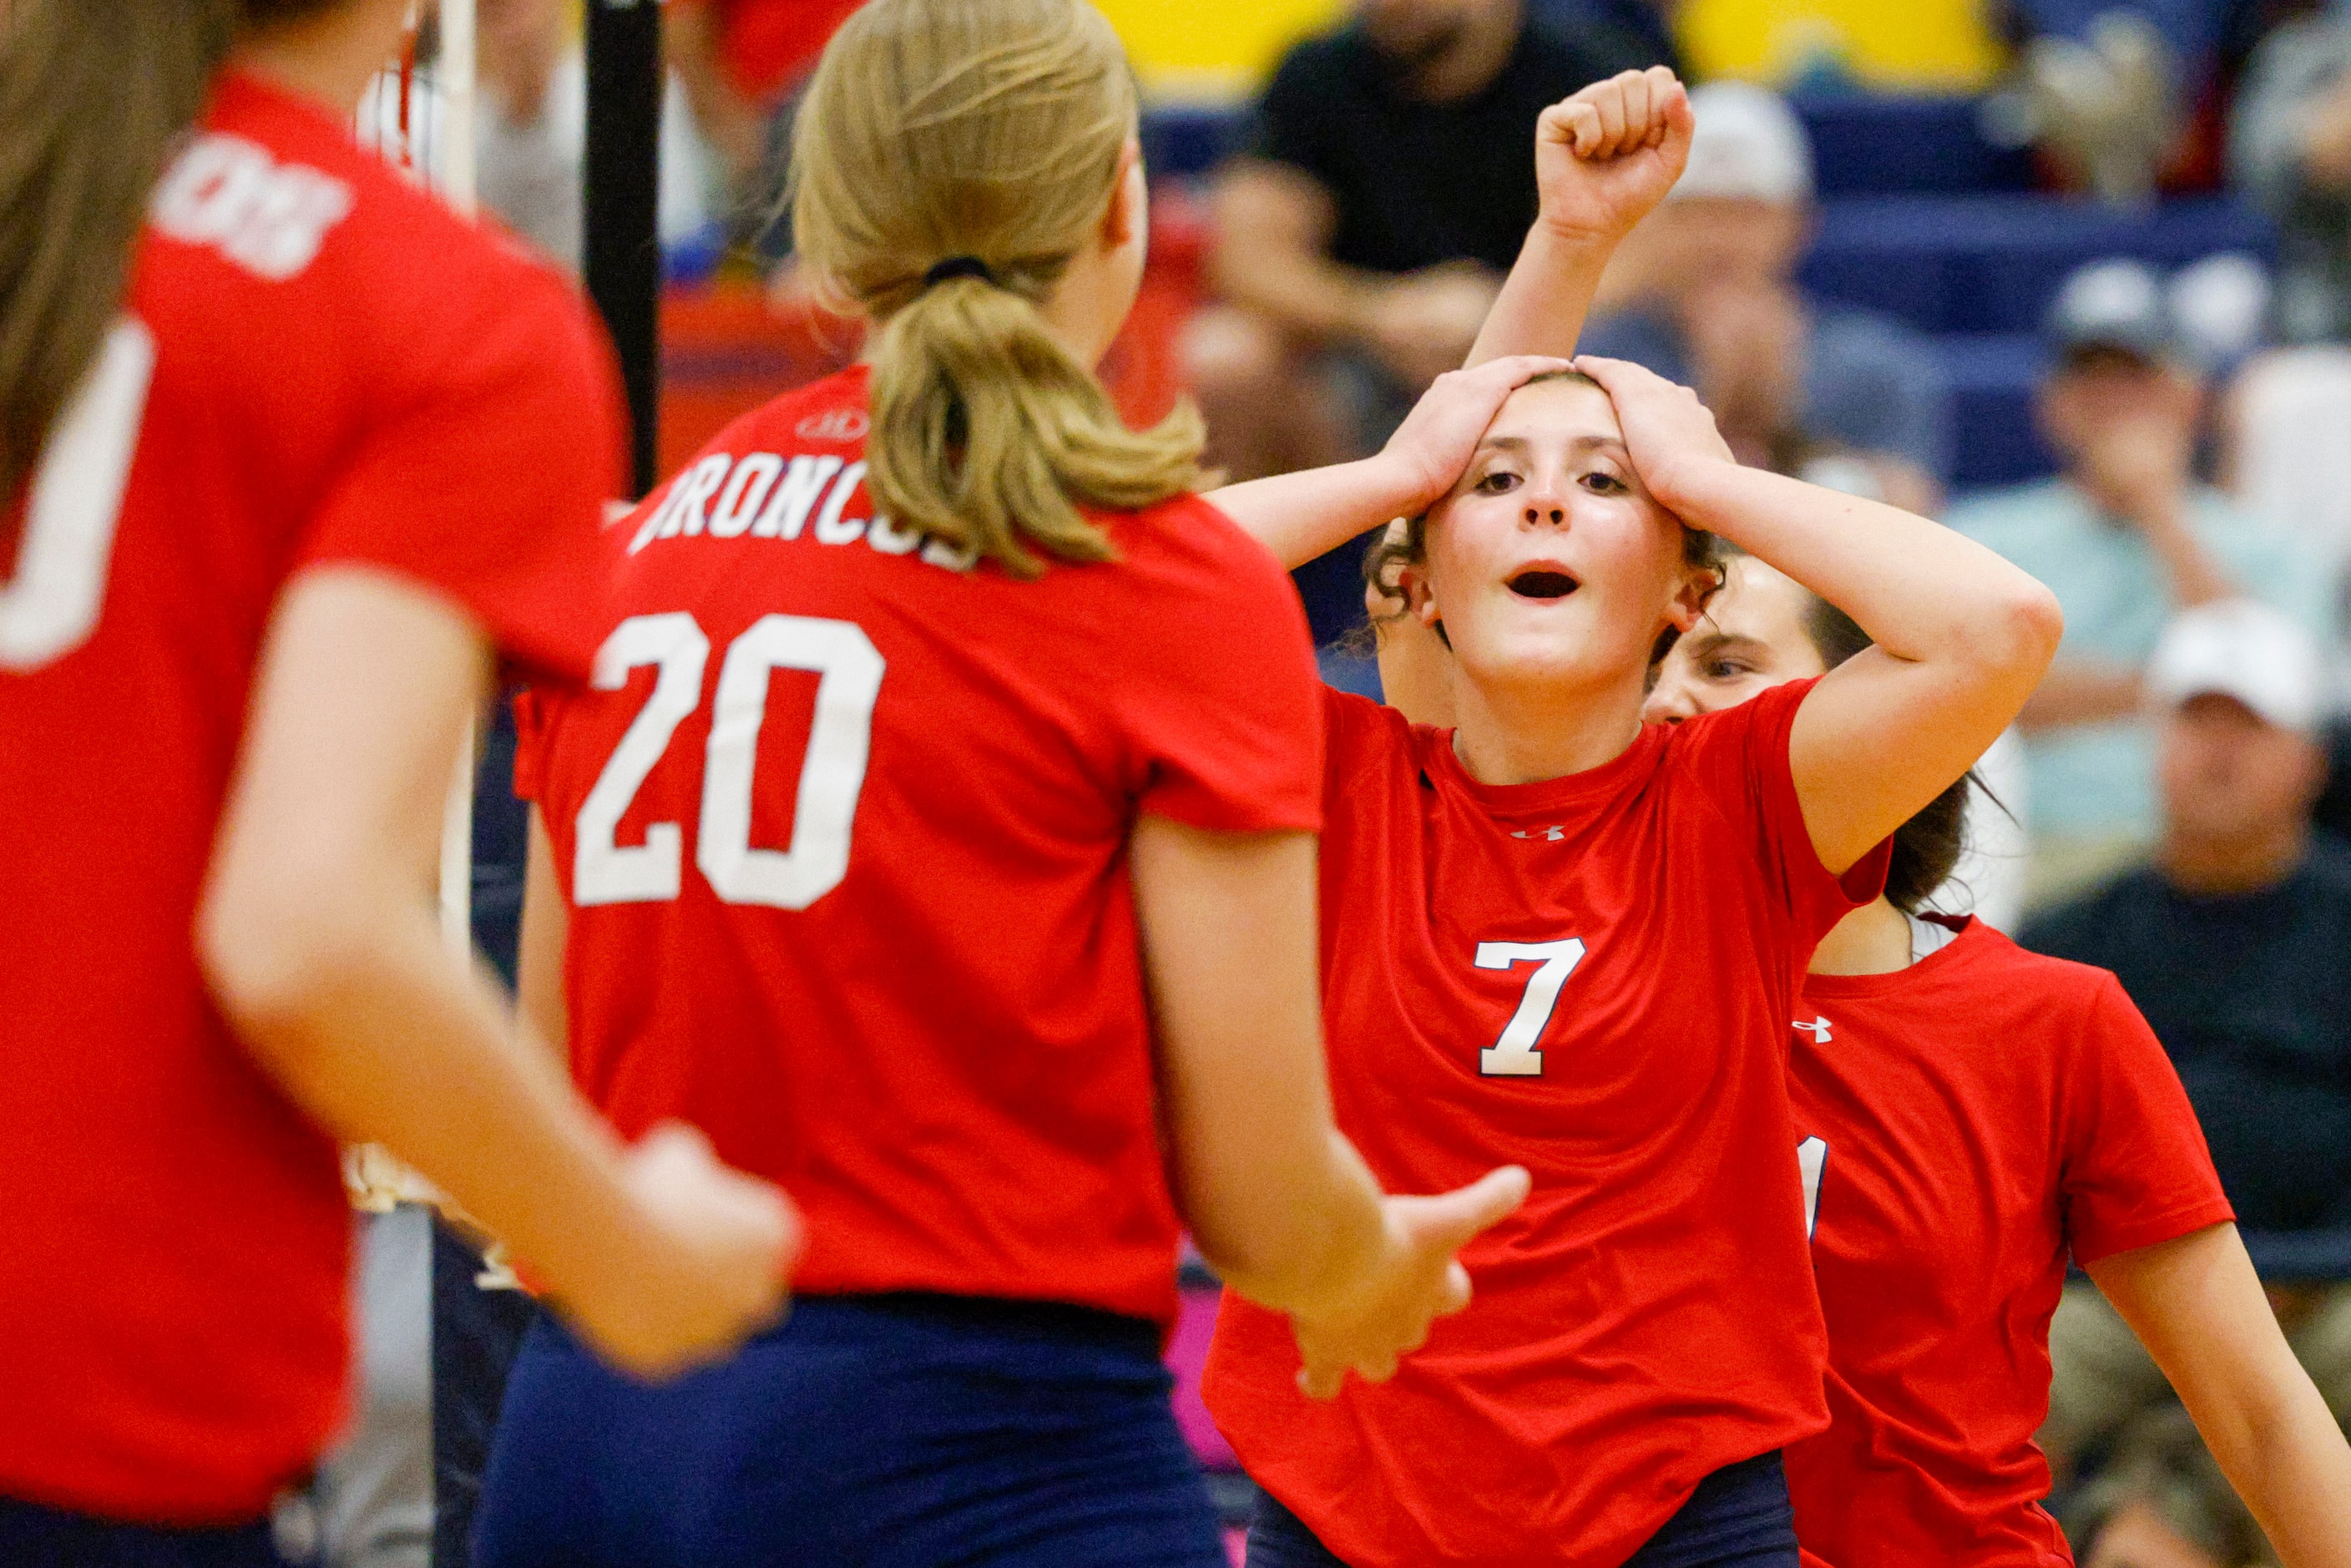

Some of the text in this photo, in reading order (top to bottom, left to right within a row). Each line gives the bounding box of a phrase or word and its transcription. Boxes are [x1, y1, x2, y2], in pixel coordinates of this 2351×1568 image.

[626, 451, 975, 572] RONC
[574, 611, 887, 910] 20
[1473, 936, 1587, 1078] 7
